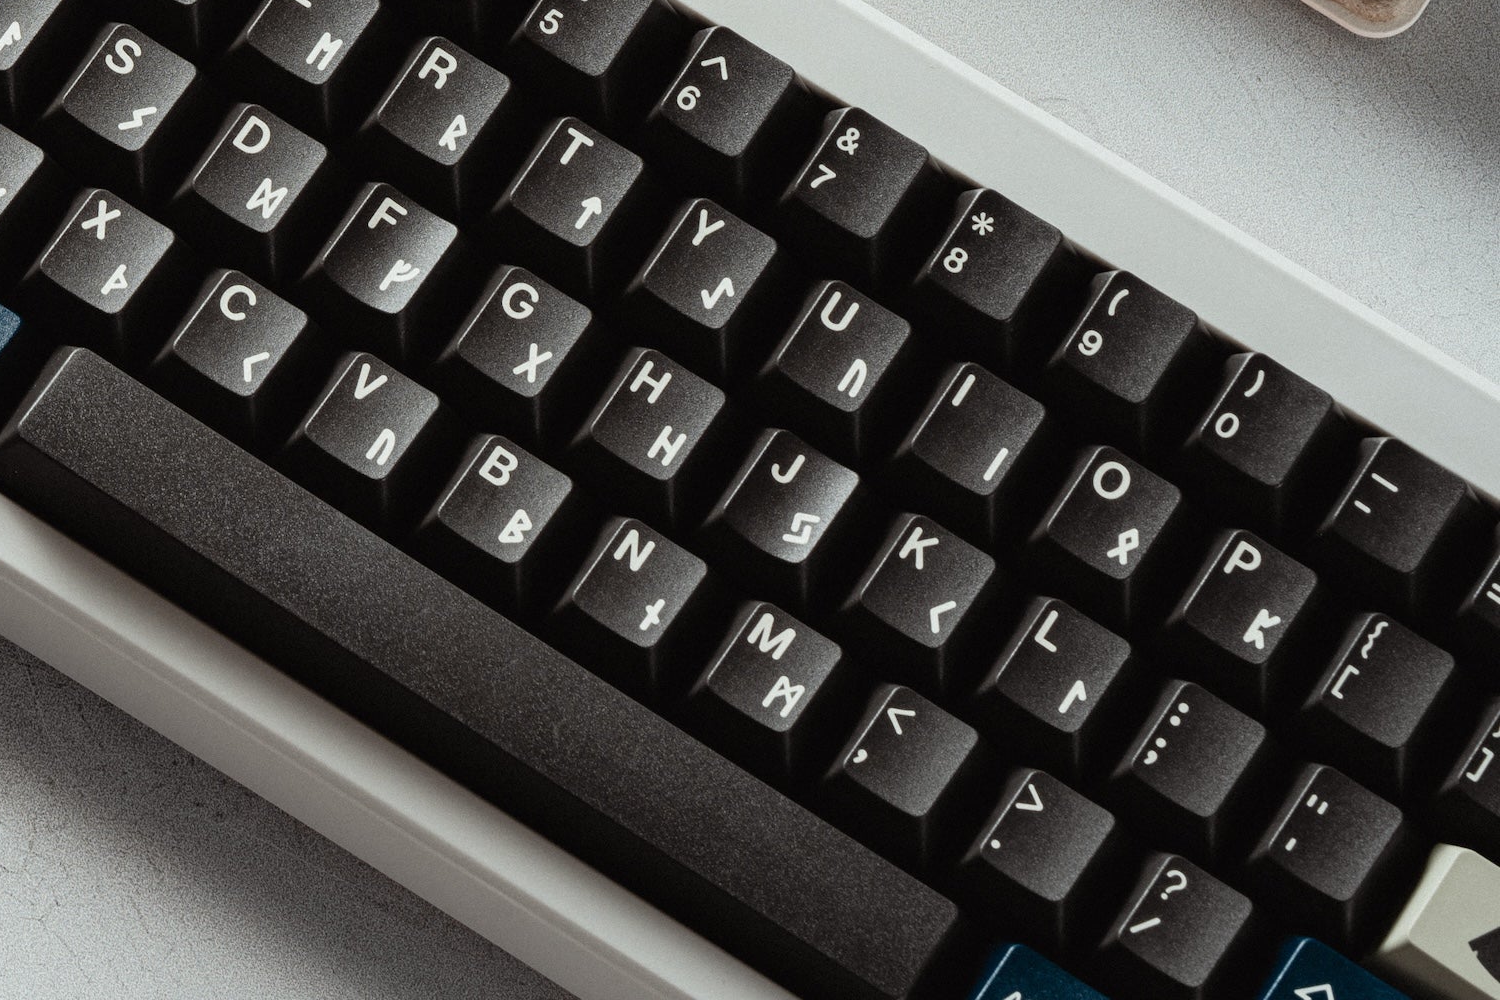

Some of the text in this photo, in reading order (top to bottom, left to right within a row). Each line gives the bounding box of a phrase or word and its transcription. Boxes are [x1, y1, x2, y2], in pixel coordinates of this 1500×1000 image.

[539, 8, 564, 35] 5
[105, 38, 142, 75] S
[418, 47, 458, 90] R
[676, 85, 701, 111] 6
[232, 115, 271, 154] D
[560, 127, 594, 165] T
[810, 164, 837, 189] 7
[81, 199, 122, 241] X
[367, 197, 408, 229] F
[692, 208, 725, 246] Y
[943, 247, 968, 273] 8
[219, 284, 257, 321] C
[501, 282, 539, 320] G
[820, 291, 860, 332] U
[1078, 330, 1103, 356] 9
[354, 363, 388, 400] V
[629, 360, 672, 404] H
[951, 374, 976, 407] I
[1215, 412, 1240, 438] 0
[478, 445, 519, 486] B
[771, 454, 806, 484] J
[1093, 461, 1131, 500] O
[613, 529, 656, 572] N
[898, 526, 939, 570] K
[1223, 540, 1262, 574] P
[747, 613, 797, 660] M
[1034, 610, 1058, 653] L
